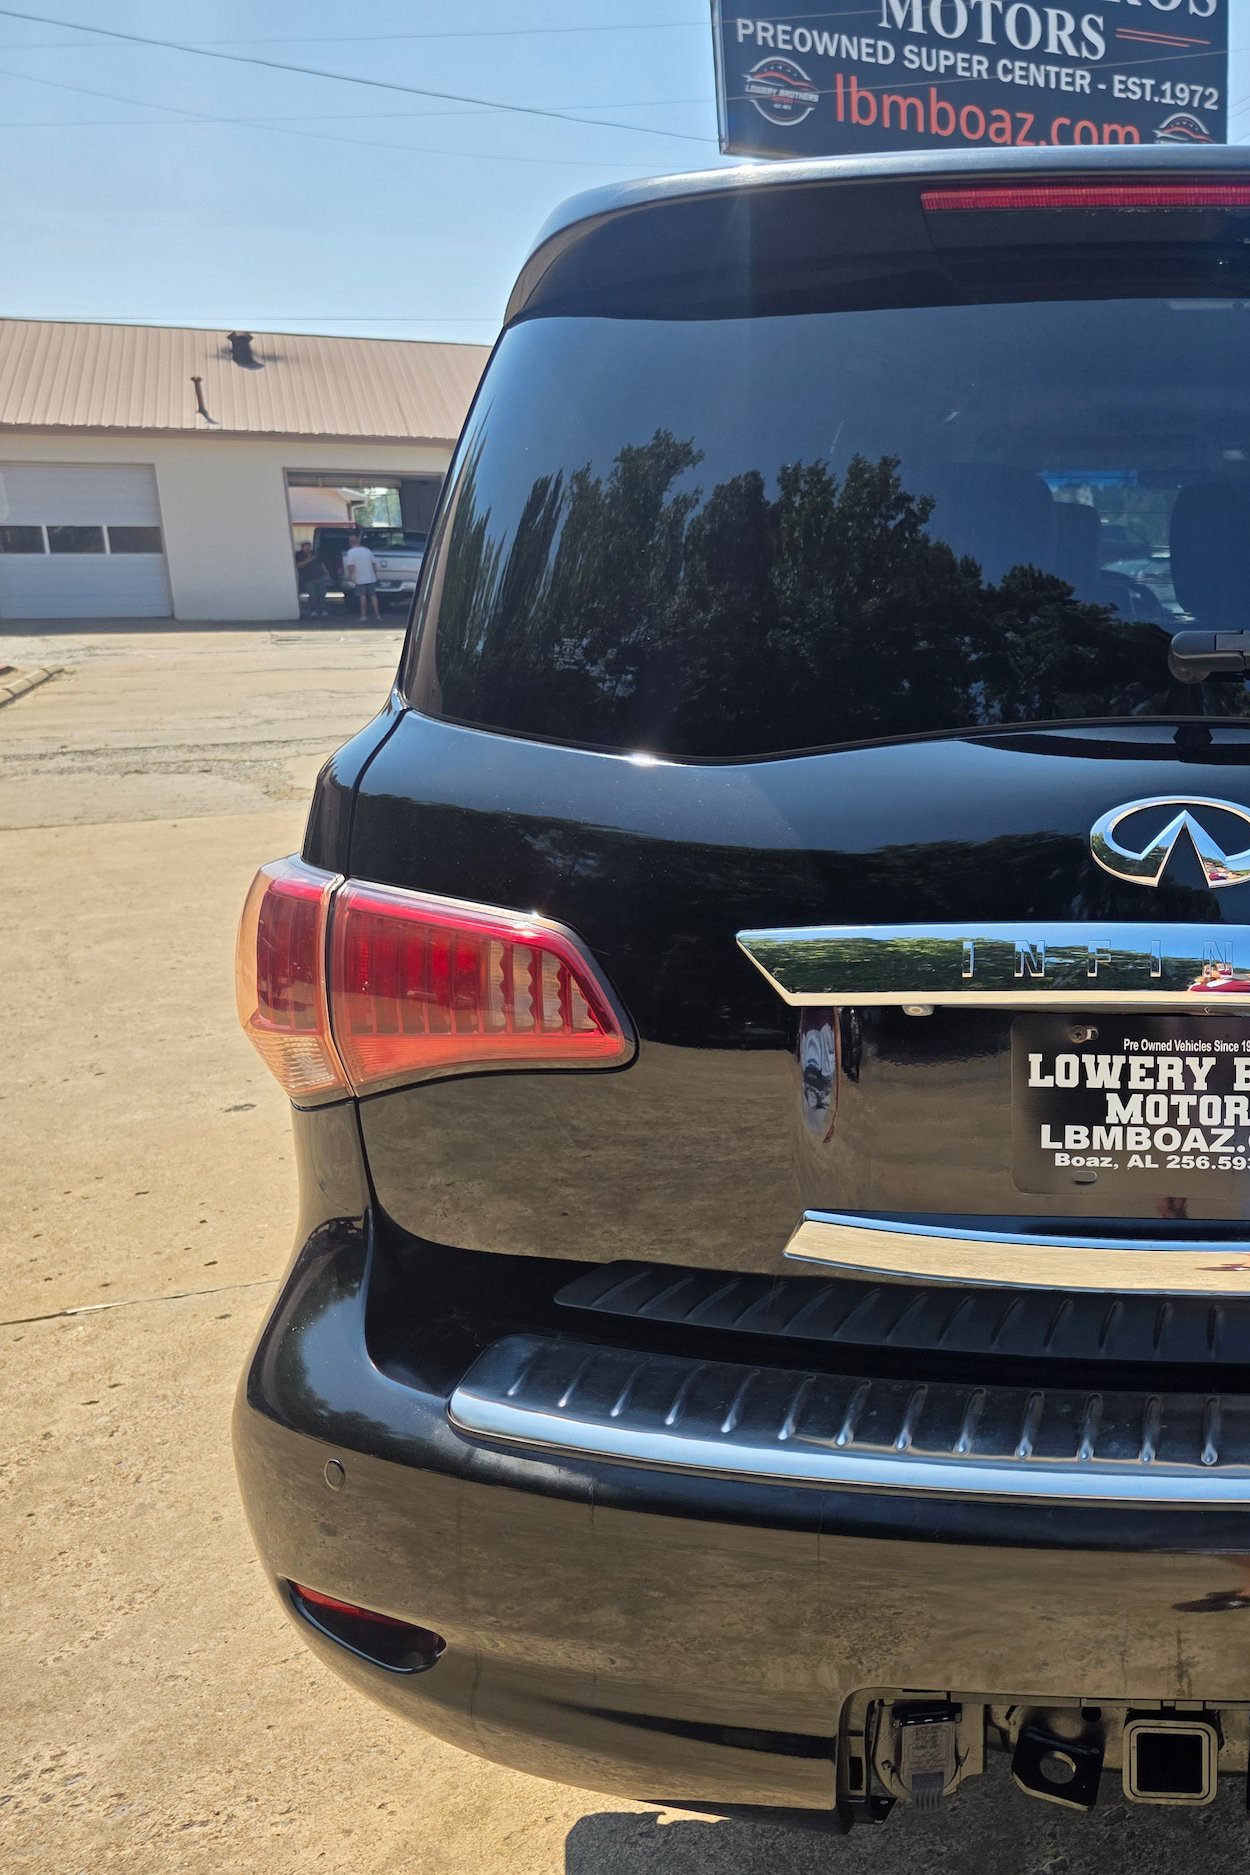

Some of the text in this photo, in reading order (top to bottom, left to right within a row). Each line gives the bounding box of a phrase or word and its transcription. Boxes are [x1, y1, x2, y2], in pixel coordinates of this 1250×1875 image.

[878, 0, 1106, 60] MOTORS
[736, 18, 896, 65] PREOWNED
[903, 45, 989, 79] SUPER
[997, 58, 1091, 93] CENTER
[1113, 74, 1219, 110] EST.1972
[836, 73, 1140, 145] lbmboaz.com
[1123, 1038, 1139, 1050] Pre
[1140, 1039, 1172, 1051] Owned
[1174, 1040, 1212, 1051] Vehicles
[1213, 1040, 1240, 1052] Since
[1028, 1053, 1216, 1091] LOWERY
[1055, 1152, 1119, 1170] Boaz,
[1127, 1154, 1159, 1169] AL
